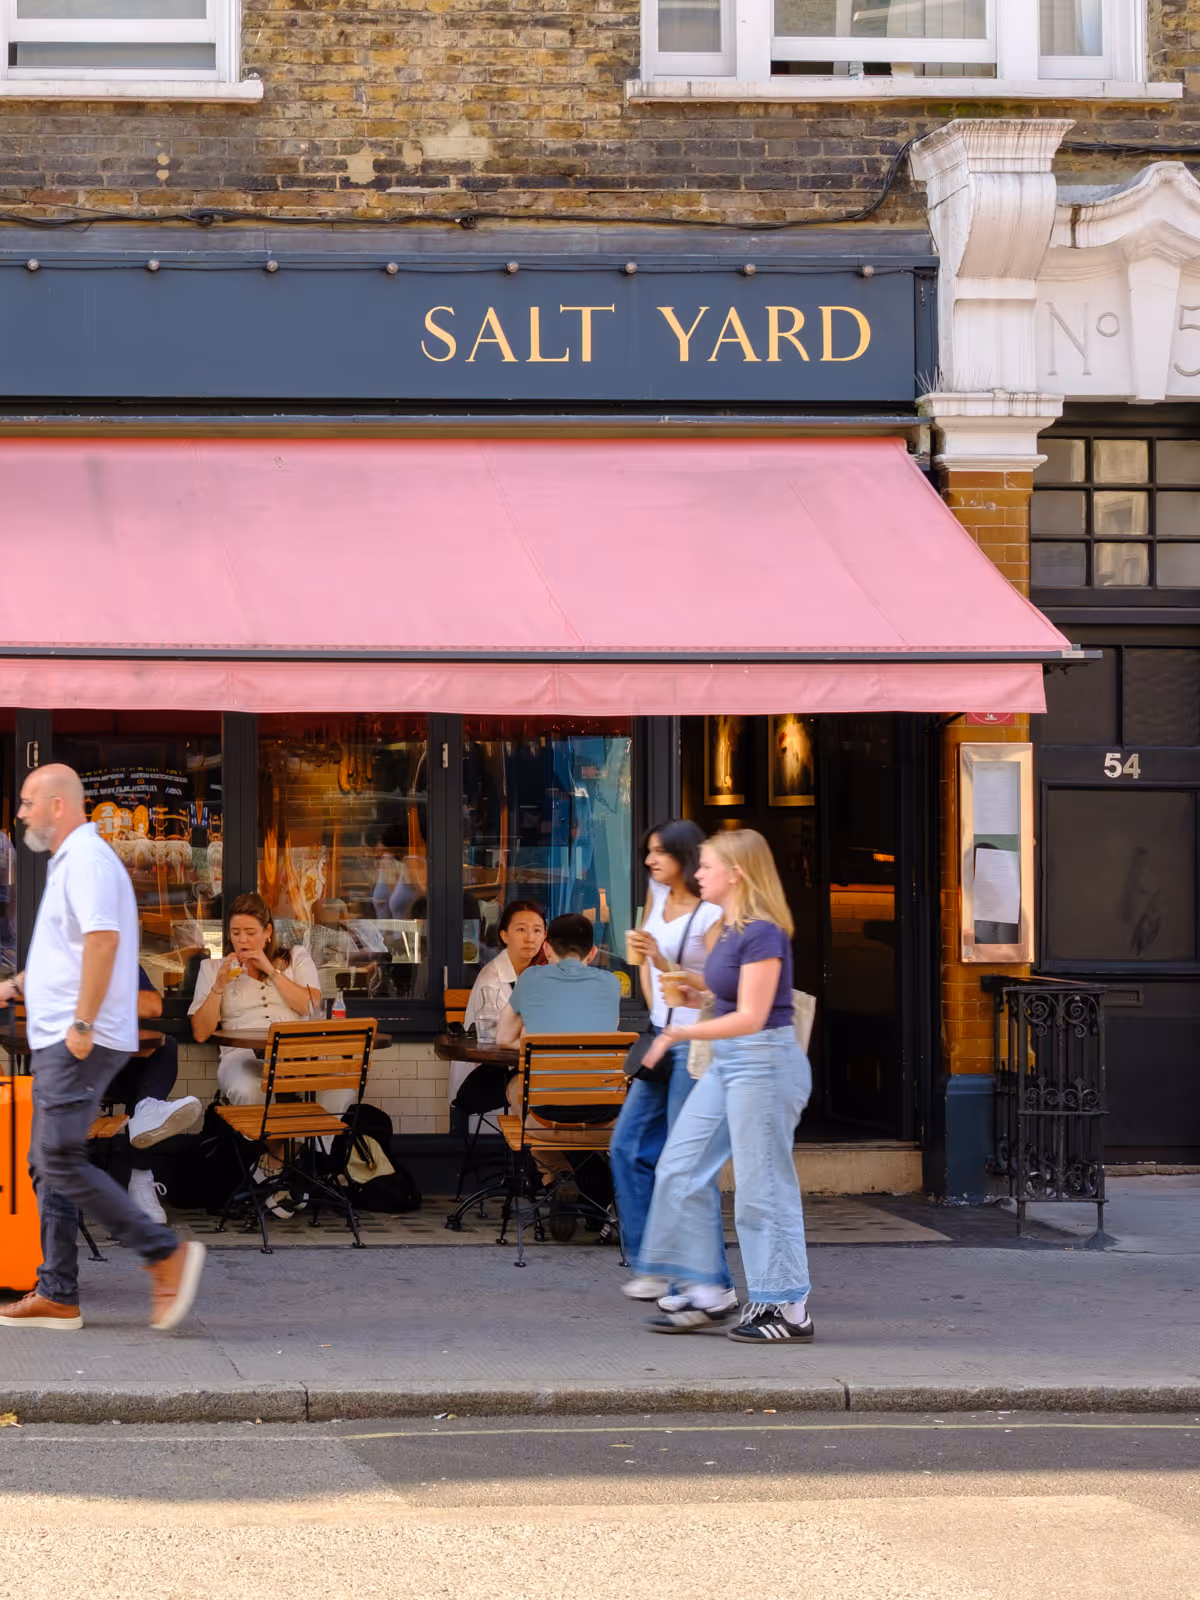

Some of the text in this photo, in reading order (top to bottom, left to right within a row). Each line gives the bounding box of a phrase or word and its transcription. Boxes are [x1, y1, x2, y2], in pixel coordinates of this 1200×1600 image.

[420, 303, 872, 363] SALT YARD
[1103, 752, 1142, 780] 54
